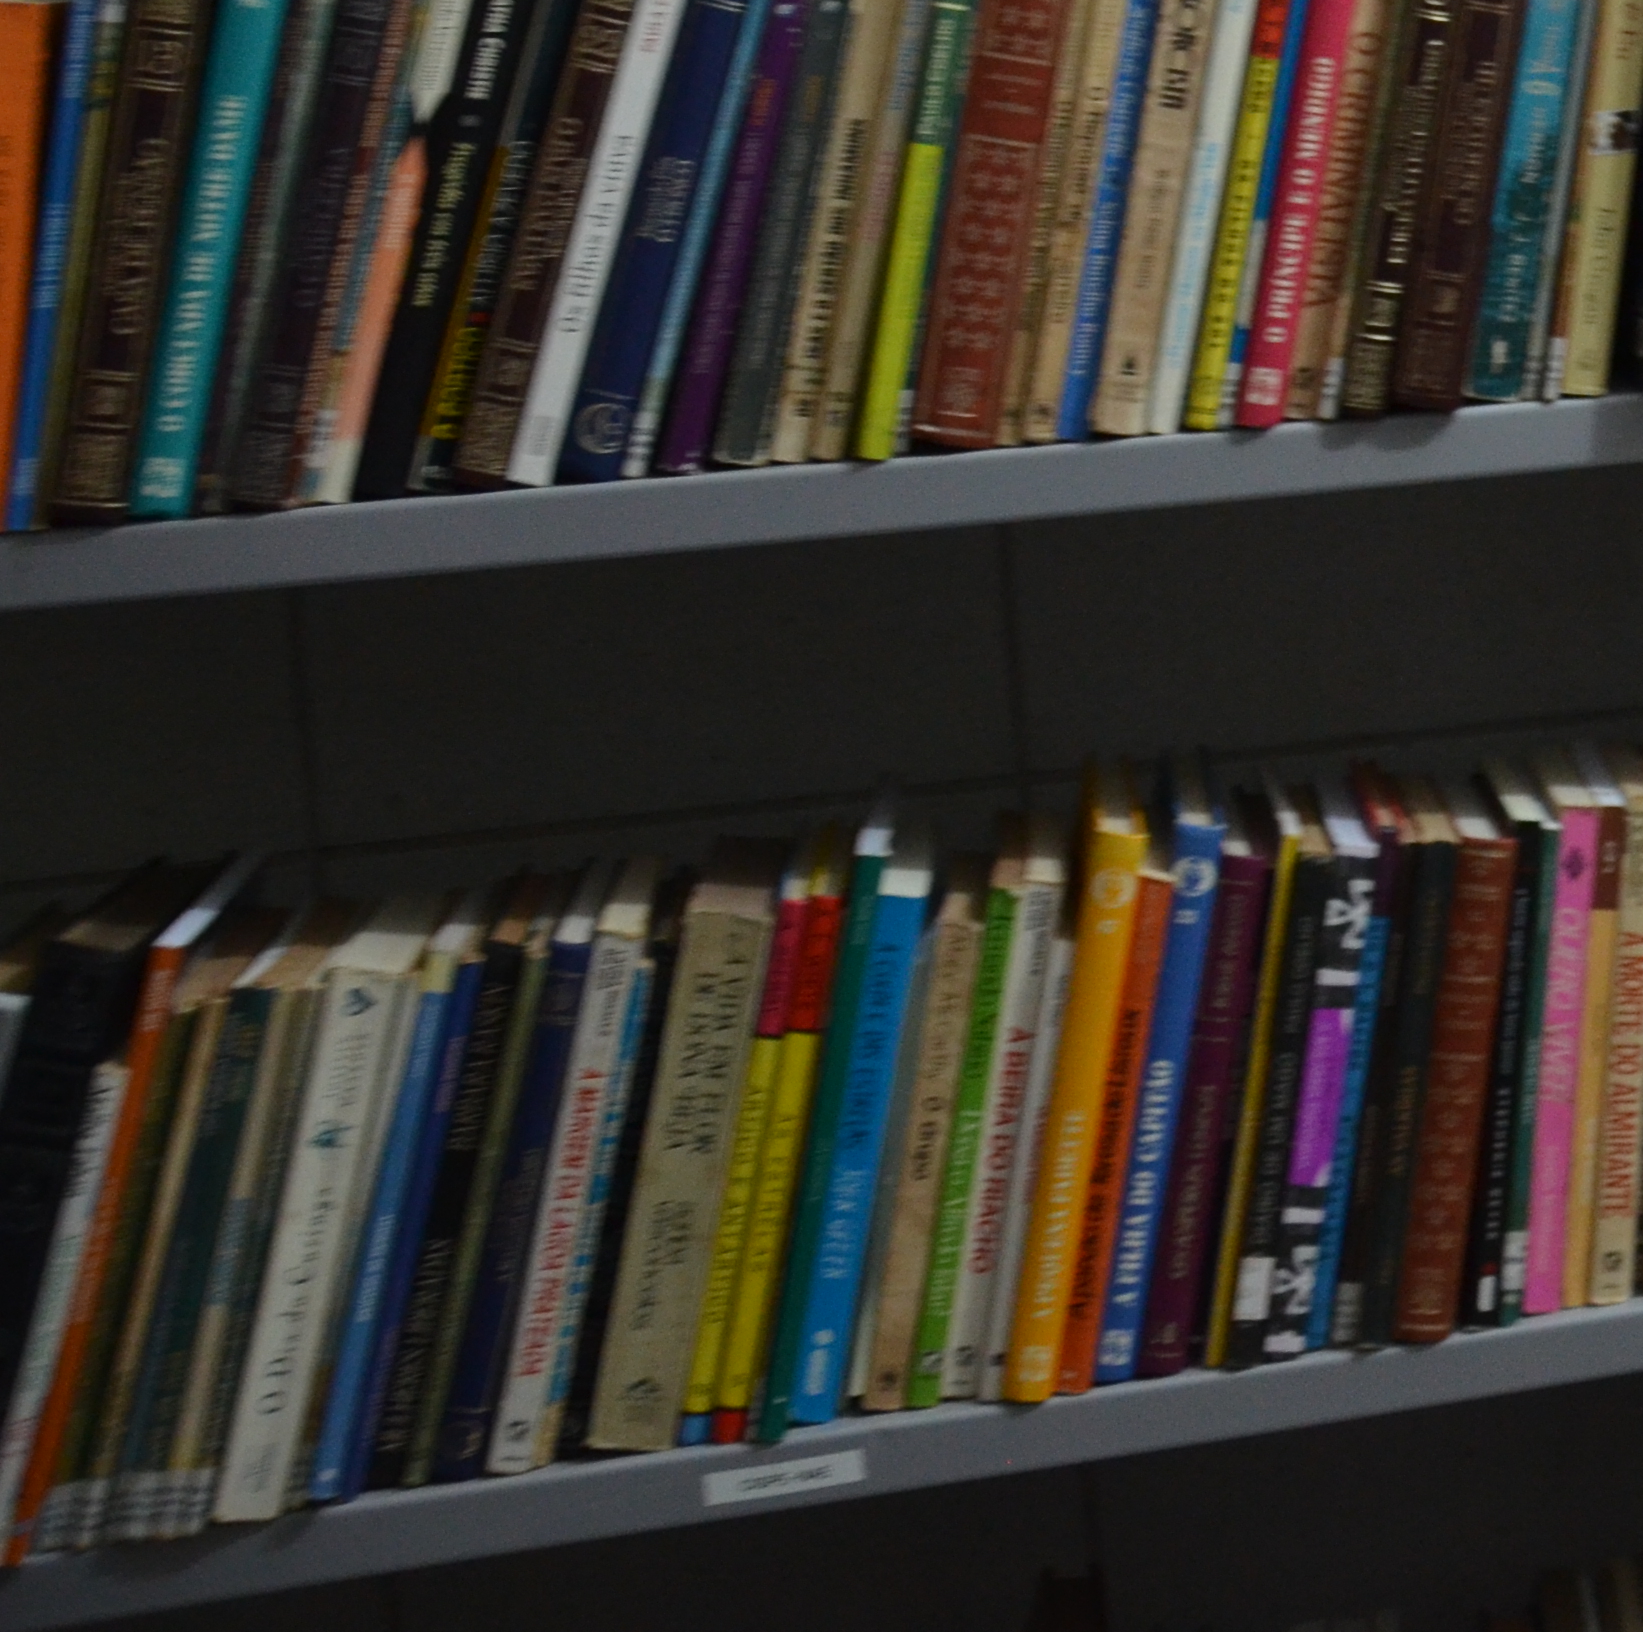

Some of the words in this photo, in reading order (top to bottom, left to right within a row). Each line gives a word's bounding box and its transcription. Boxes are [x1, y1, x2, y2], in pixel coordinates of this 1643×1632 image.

[1353, 30, 1385, 57] O
[465, 38, 507, 100] CHRISTIE
[1294, 56, 1335, 162] MENDIGO
[1292, 167, 1317, 185] O
[1306, 66, 1378, 309] CRIMINALISTA
[1289, 188, 1313, 205] E
[184, 251, 217, 280] DE
[1264, 326, 1287, 343] O
[1552, 905, 1588, 1010] QUERO
[1612, 1043, 1642, 1078] DO
[992, 1050, 1031, 1129] BEIRA
[1134, 1060, 1175, 1163] CAPITÃO
[988, 1133, 1016, 1171] DO
[1602, 1083, 1642, 1219] ALMIRANTE
[556, 1175, 582, 1201] DA
[1130, 1172, 1157, 1206] DO
[970, 1176, 1011, 1275] RIACHO
[1118, 1211, 1154, 1286] FILHA
[1115, 1292, 1138, 1309] A
